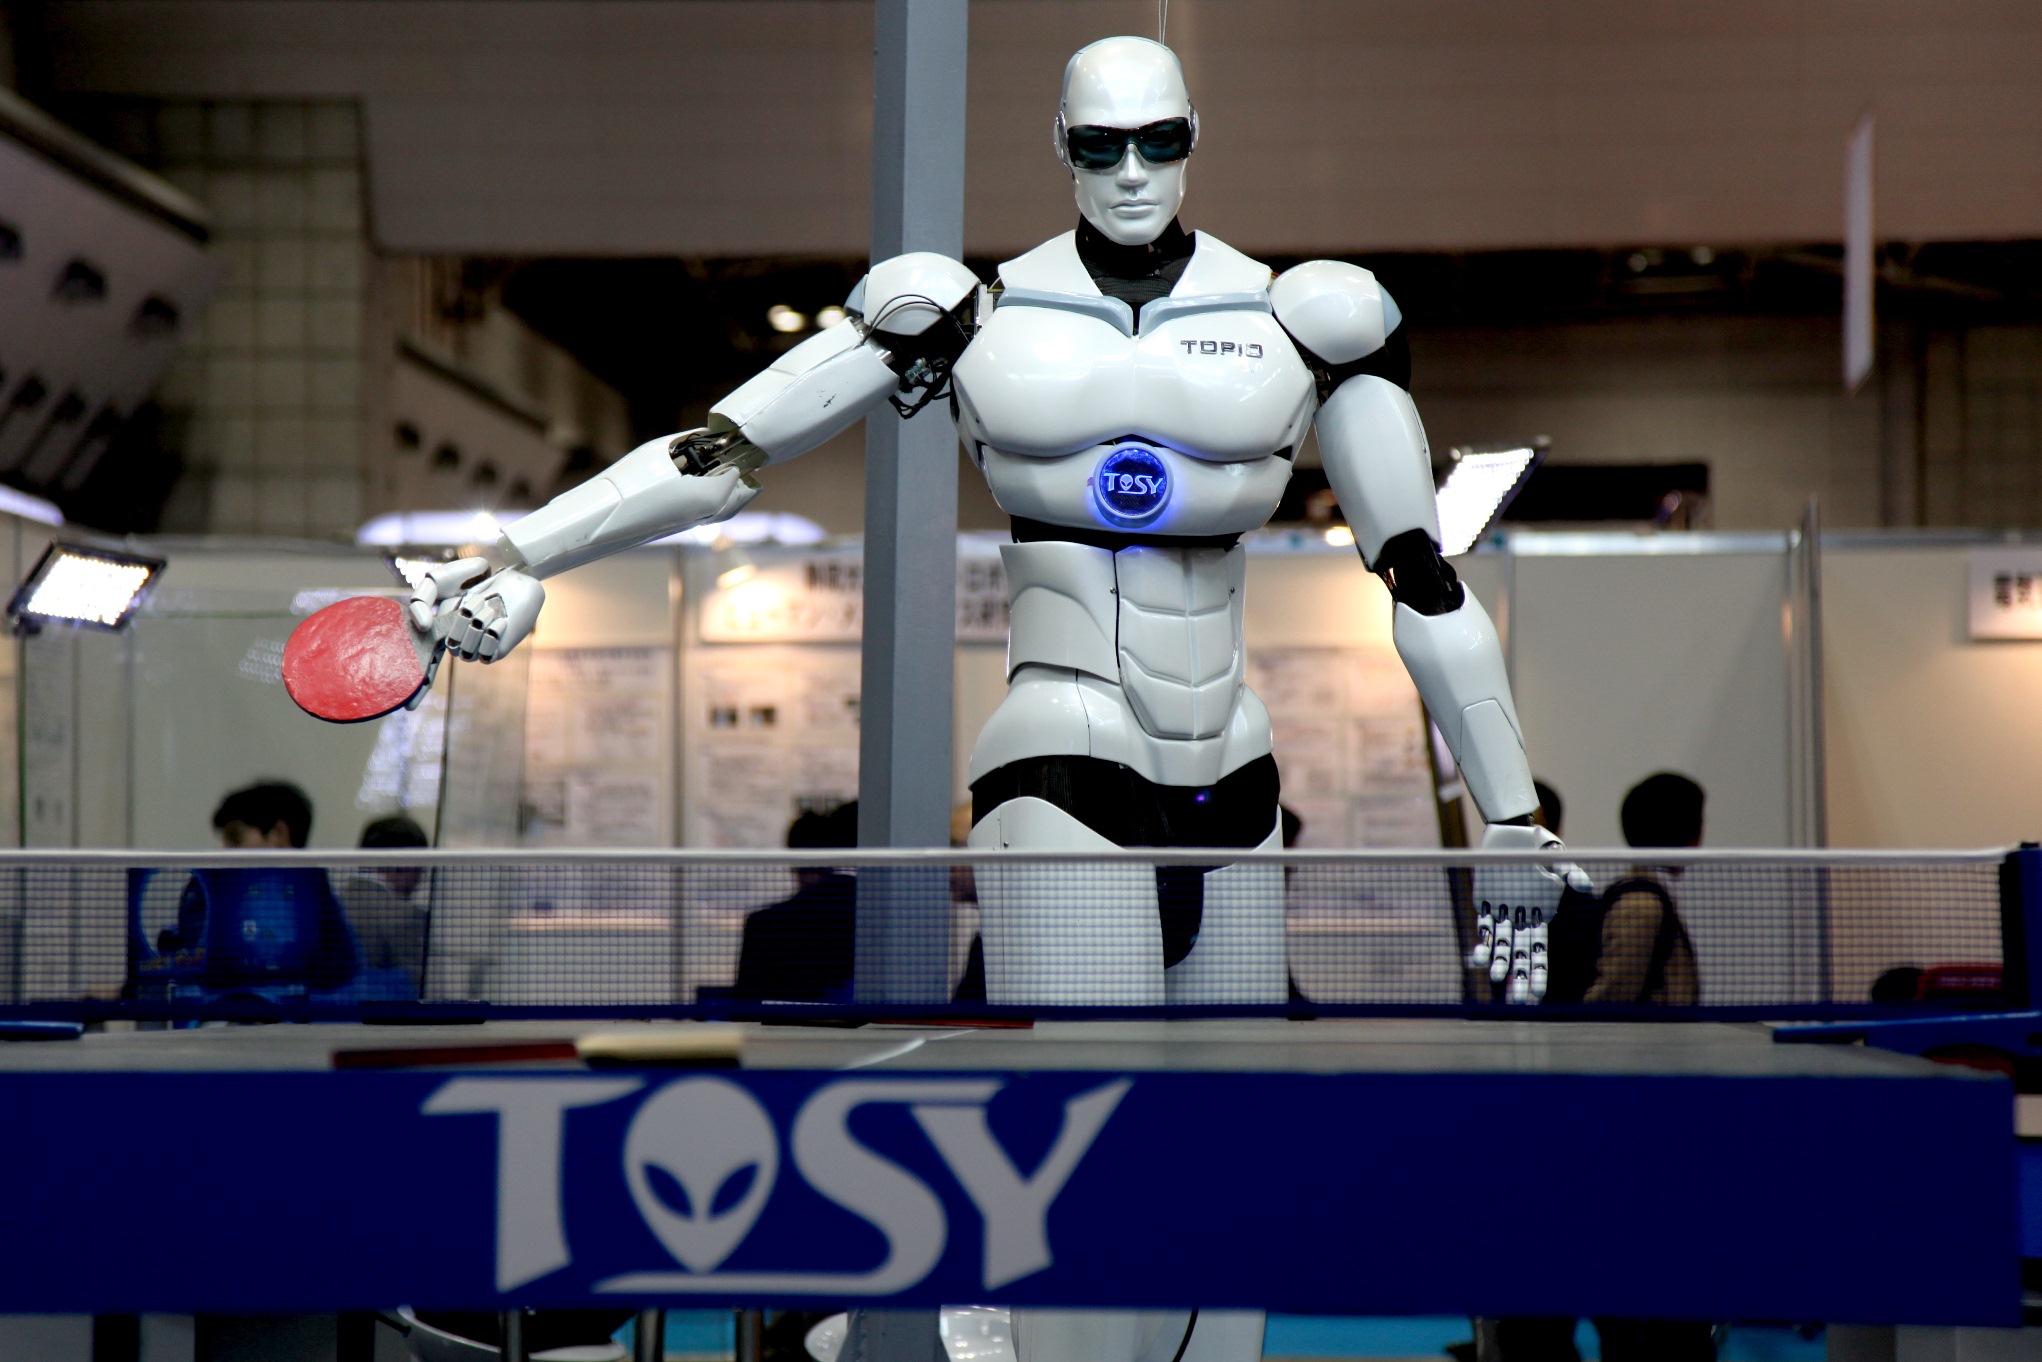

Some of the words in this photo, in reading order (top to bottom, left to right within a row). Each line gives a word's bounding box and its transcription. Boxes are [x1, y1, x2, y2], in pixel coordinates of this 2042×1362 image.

[1180, 340, 1263, 358] TOPIO
[1103, 472, 1164, 495] TOSY
[420, 1076, 1133, 1295] TOSY
